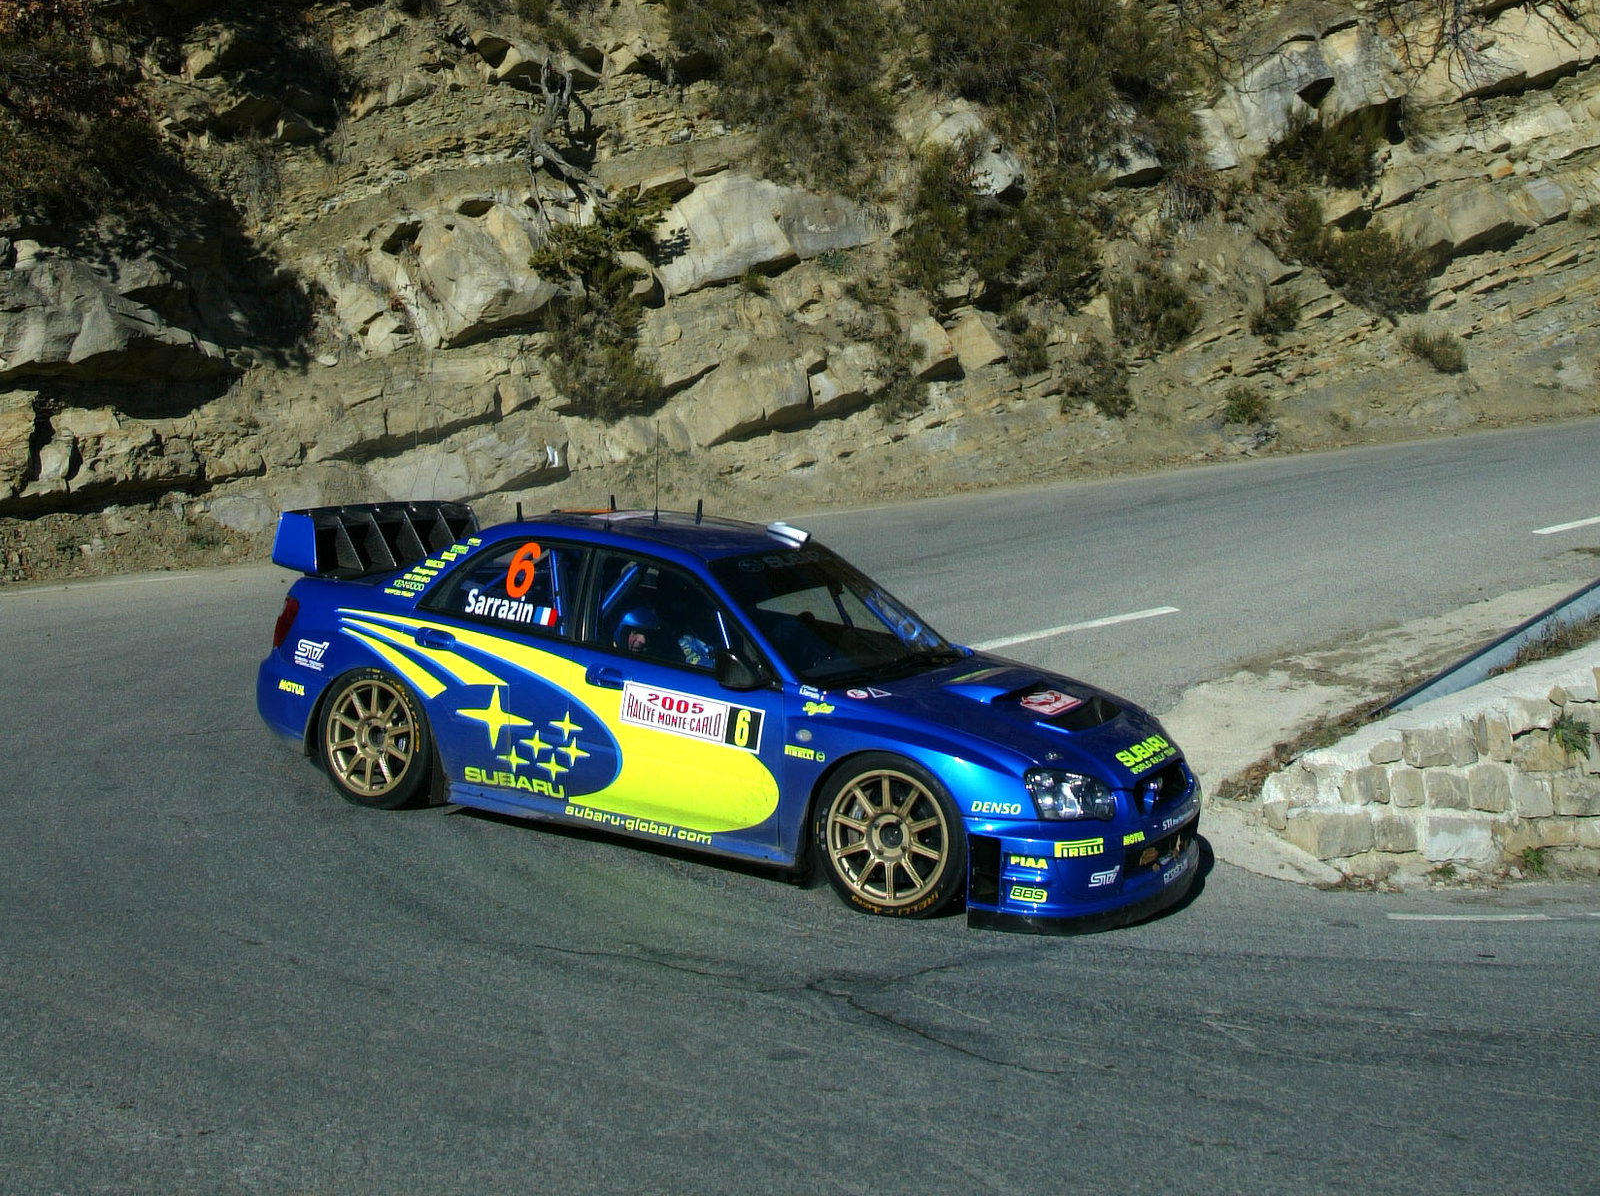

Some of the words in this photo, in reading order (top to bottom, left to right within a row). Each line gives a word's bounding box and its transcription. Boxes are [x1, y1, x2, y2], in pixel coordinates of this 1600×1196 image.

[505, 542, 542, 599] 6
[465, 588, 534, 623] Sarrazin
[279, 679, 305, 696] MOTUL
[626, 692, 656, 723] RALLYE
[647, 693, 705, 714] 2005
[734, 709, 751, 747] 6
[1115, 734, 1169, 768] SUBARU
[464, 766, 566, 799] SUBARU
[970, 800, 1022, 815] DENSO
[564, 805, 713, 845] subaru-global.com
[1010, 855, 1048, 870] PIAA
[1054, 837, 1104, 858] PIRELLI
[1011, 887, 1045, 901] BBS
